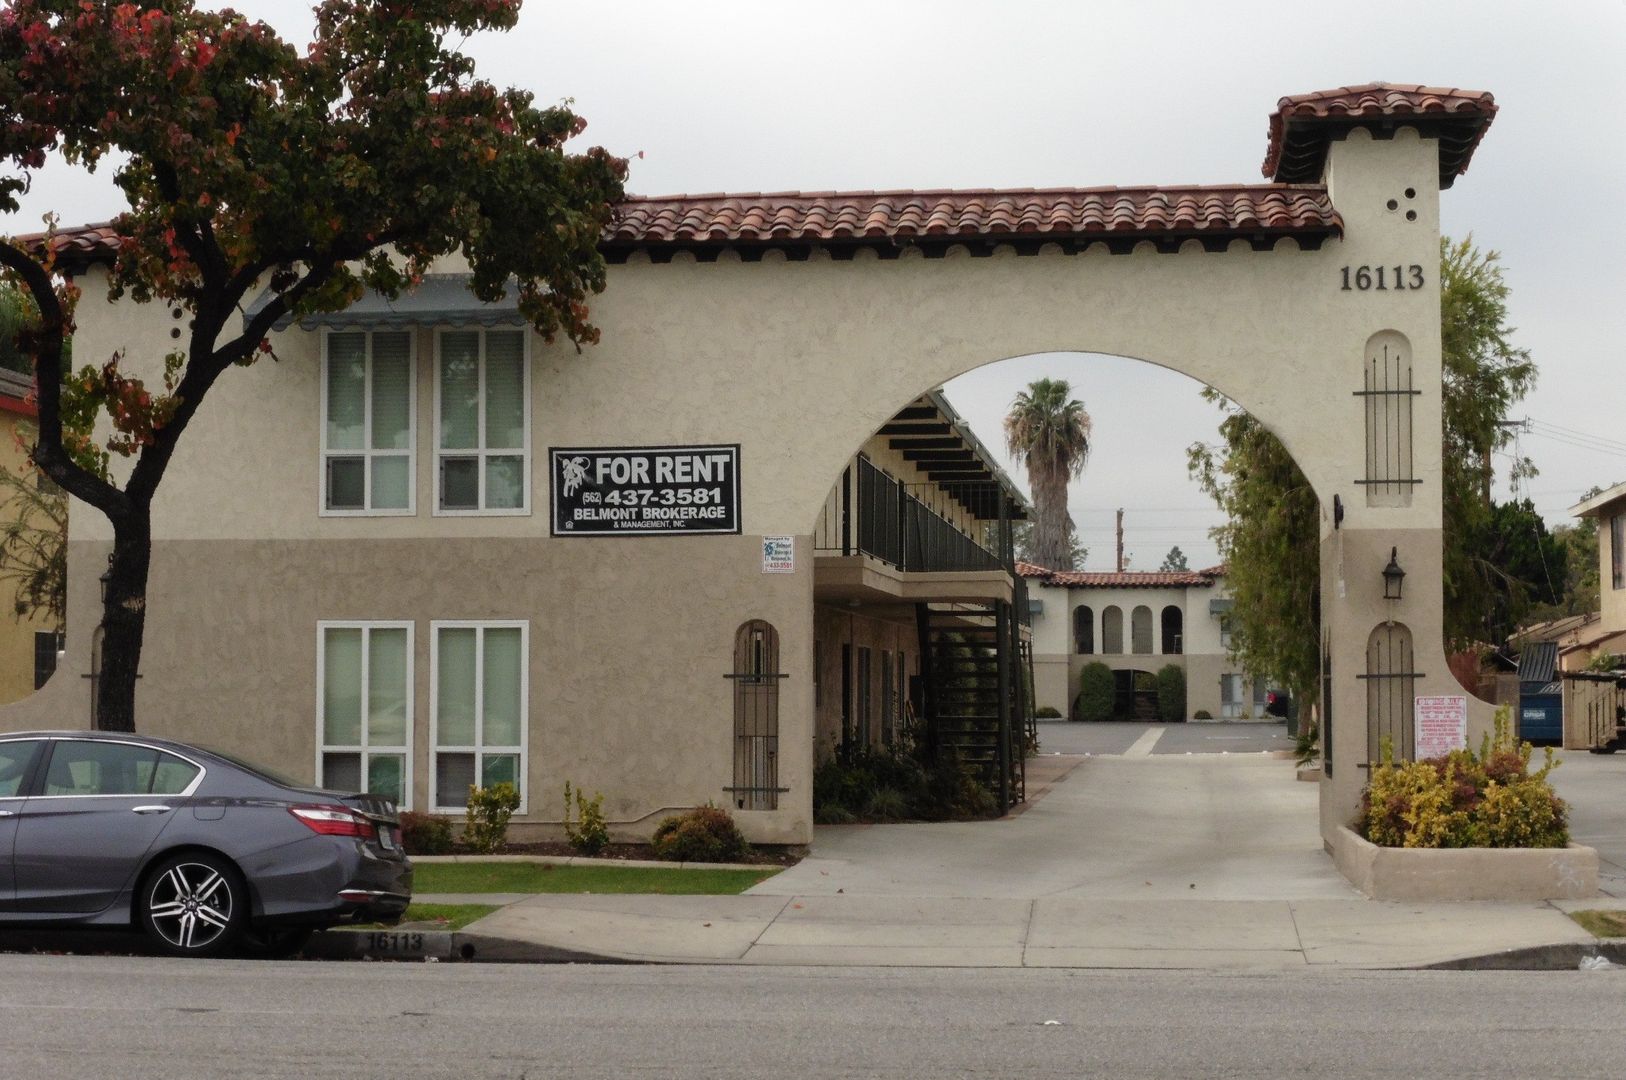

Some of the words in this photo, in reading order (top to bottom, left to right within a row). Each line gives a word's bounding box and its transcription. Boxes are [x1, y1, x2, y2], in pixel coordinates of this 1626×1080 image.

[1340, 264, 1425, 291] 16113
[596, 456, 651, 485] FOR
[655, 454, 731, 484] RENT
[582, 491, 602, 506] (562)
[605, 487, 721, 506] 437-3581
[573, 507, 639, 521] BELMONT
[642, 506, 726, 520] BROKERAGE
[613, 521, 619, 529] &
[620, 521, 672, 529] MANAGEMENT,
[672, 520, 686, 528] INC.
[367, 931, 423, 951] 16113
